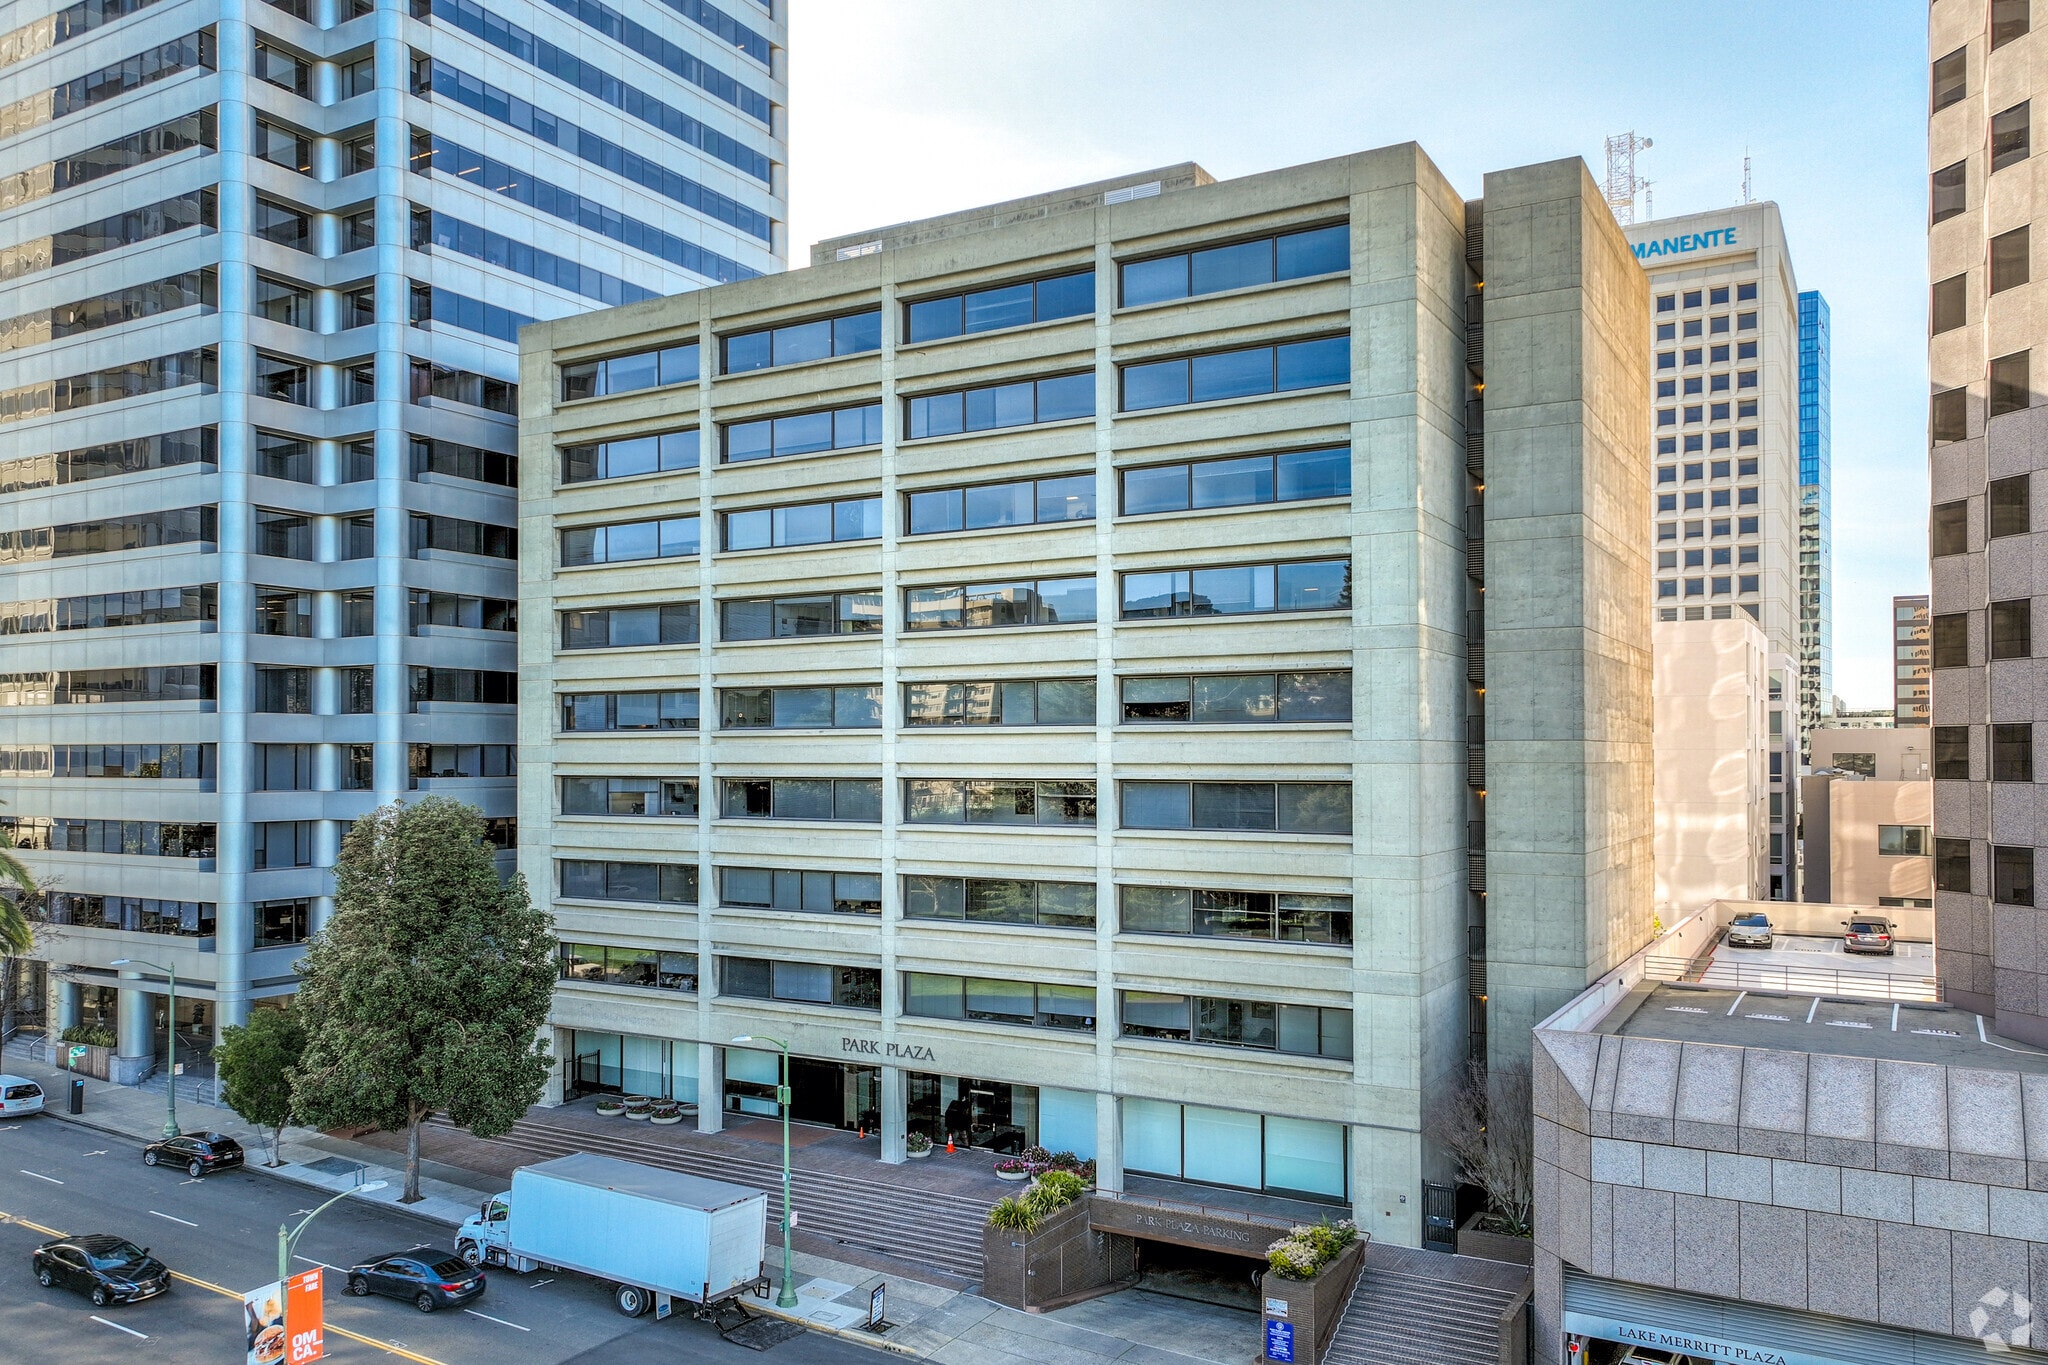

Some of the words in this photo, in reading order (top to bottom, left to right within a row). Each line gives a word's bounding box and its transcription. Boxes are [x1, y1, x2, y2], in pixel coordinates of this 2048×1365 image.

[1630, 227, 1737, 259] MANENTE
[842, 1037, 880, 1055] PARK
[886, 1042, 936, 1061] PLAZA
[1165, 1219, 1200, 1234] PLAZA
[1203, 1225, 1250, 1242] PARKING
[1618, 1326, 1657, 1343] LAKE
[1659, 1334, 1732, 1356] MERRITT
[1734, 1349, 1786, 1365] PLAZA
